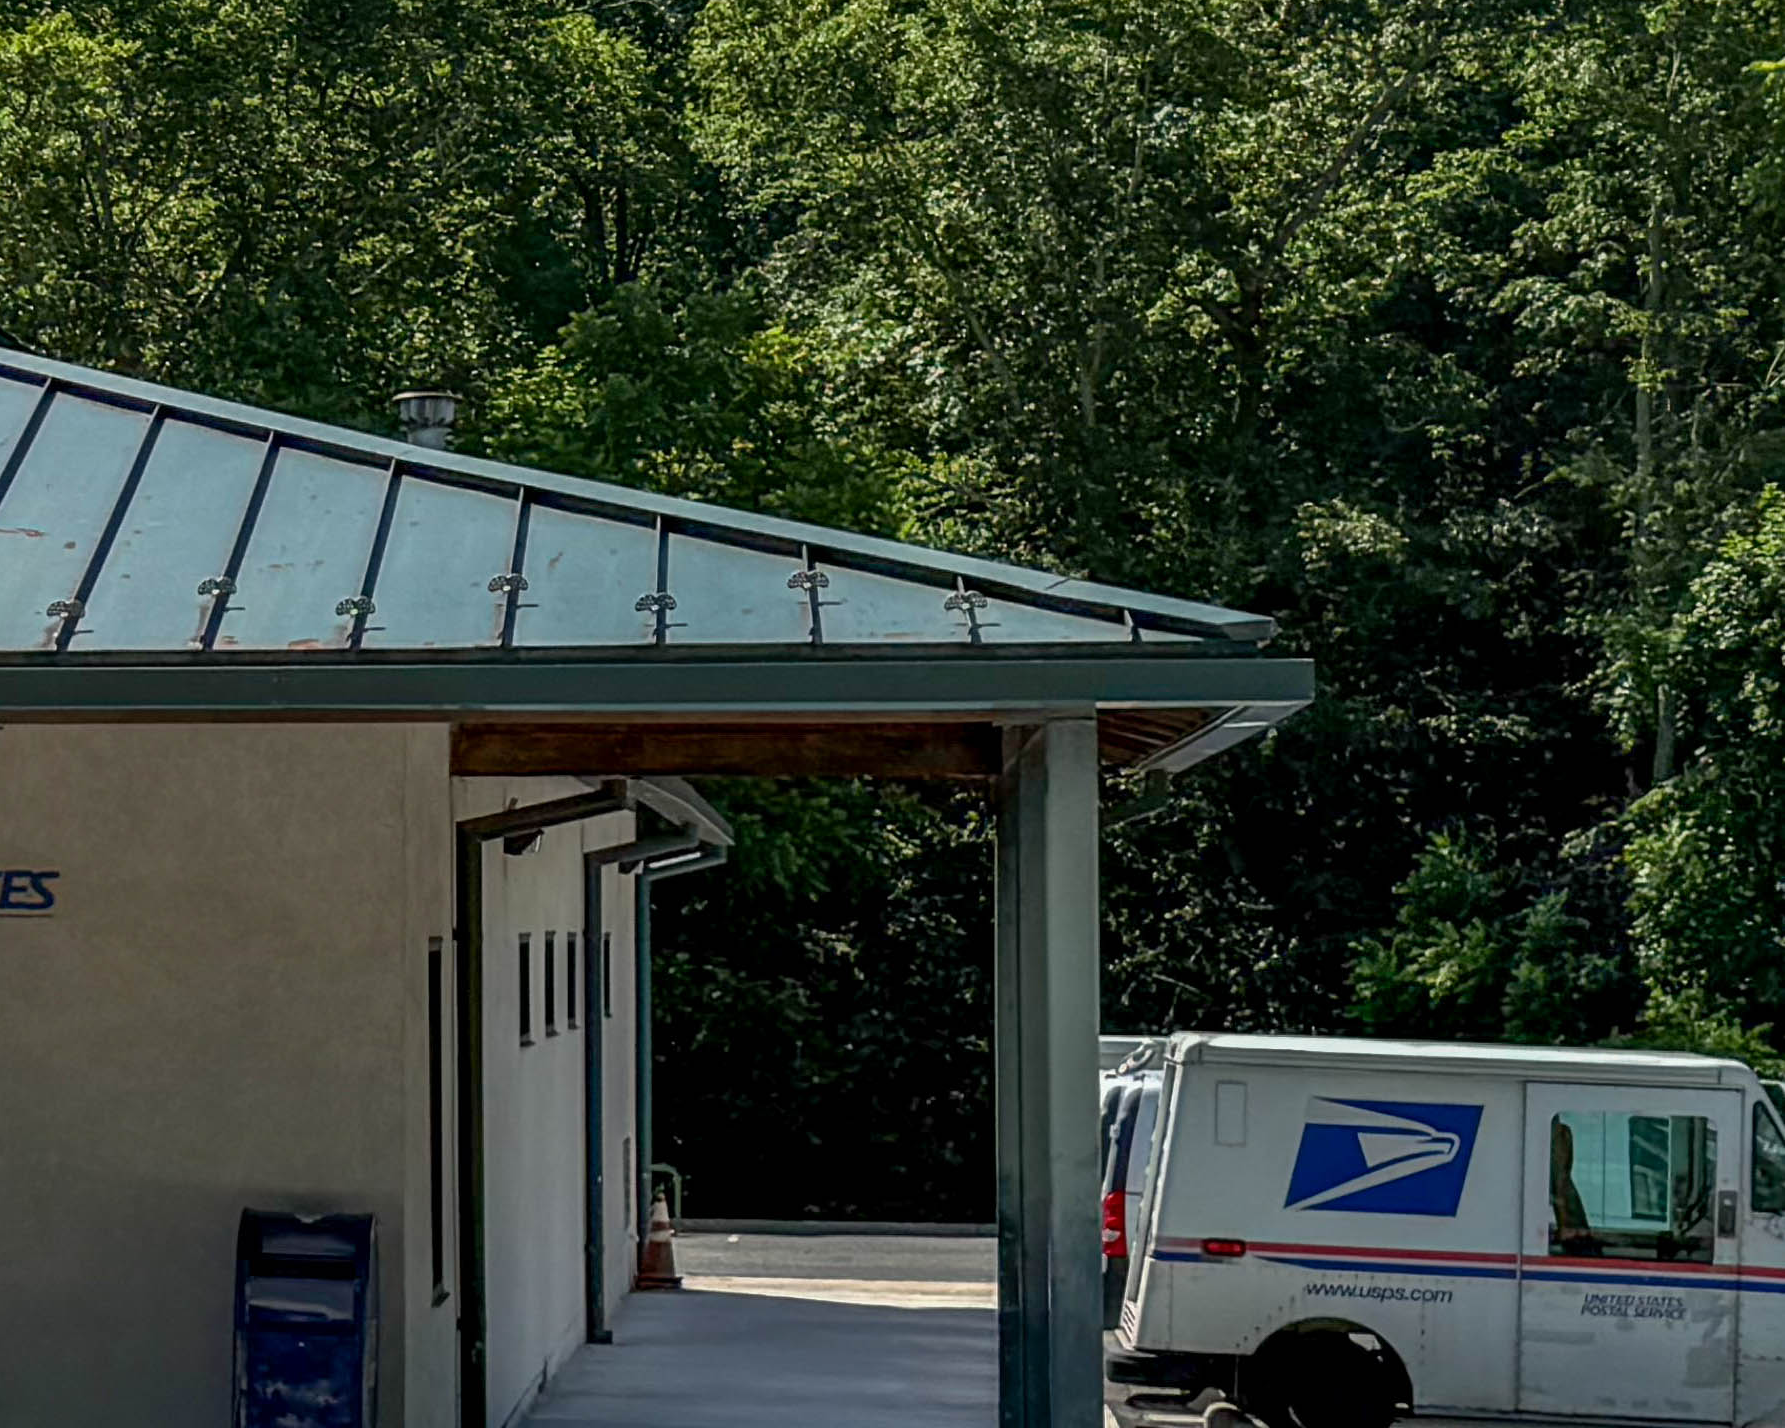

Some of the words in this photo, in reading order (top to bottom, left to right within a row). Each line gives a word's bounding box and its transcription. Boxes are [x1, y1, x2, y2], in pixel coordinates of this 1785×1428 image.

[1305, 1283, 1454, 1304] www.usps.com
[1584, 1293, 1635, 1306] UNITED
[1636, 1295, 1684, 1308] STATES
[1580, 1304, 1628, 1317] POSTAL
[1633, 1306, 1687, 1319] SERVICE
